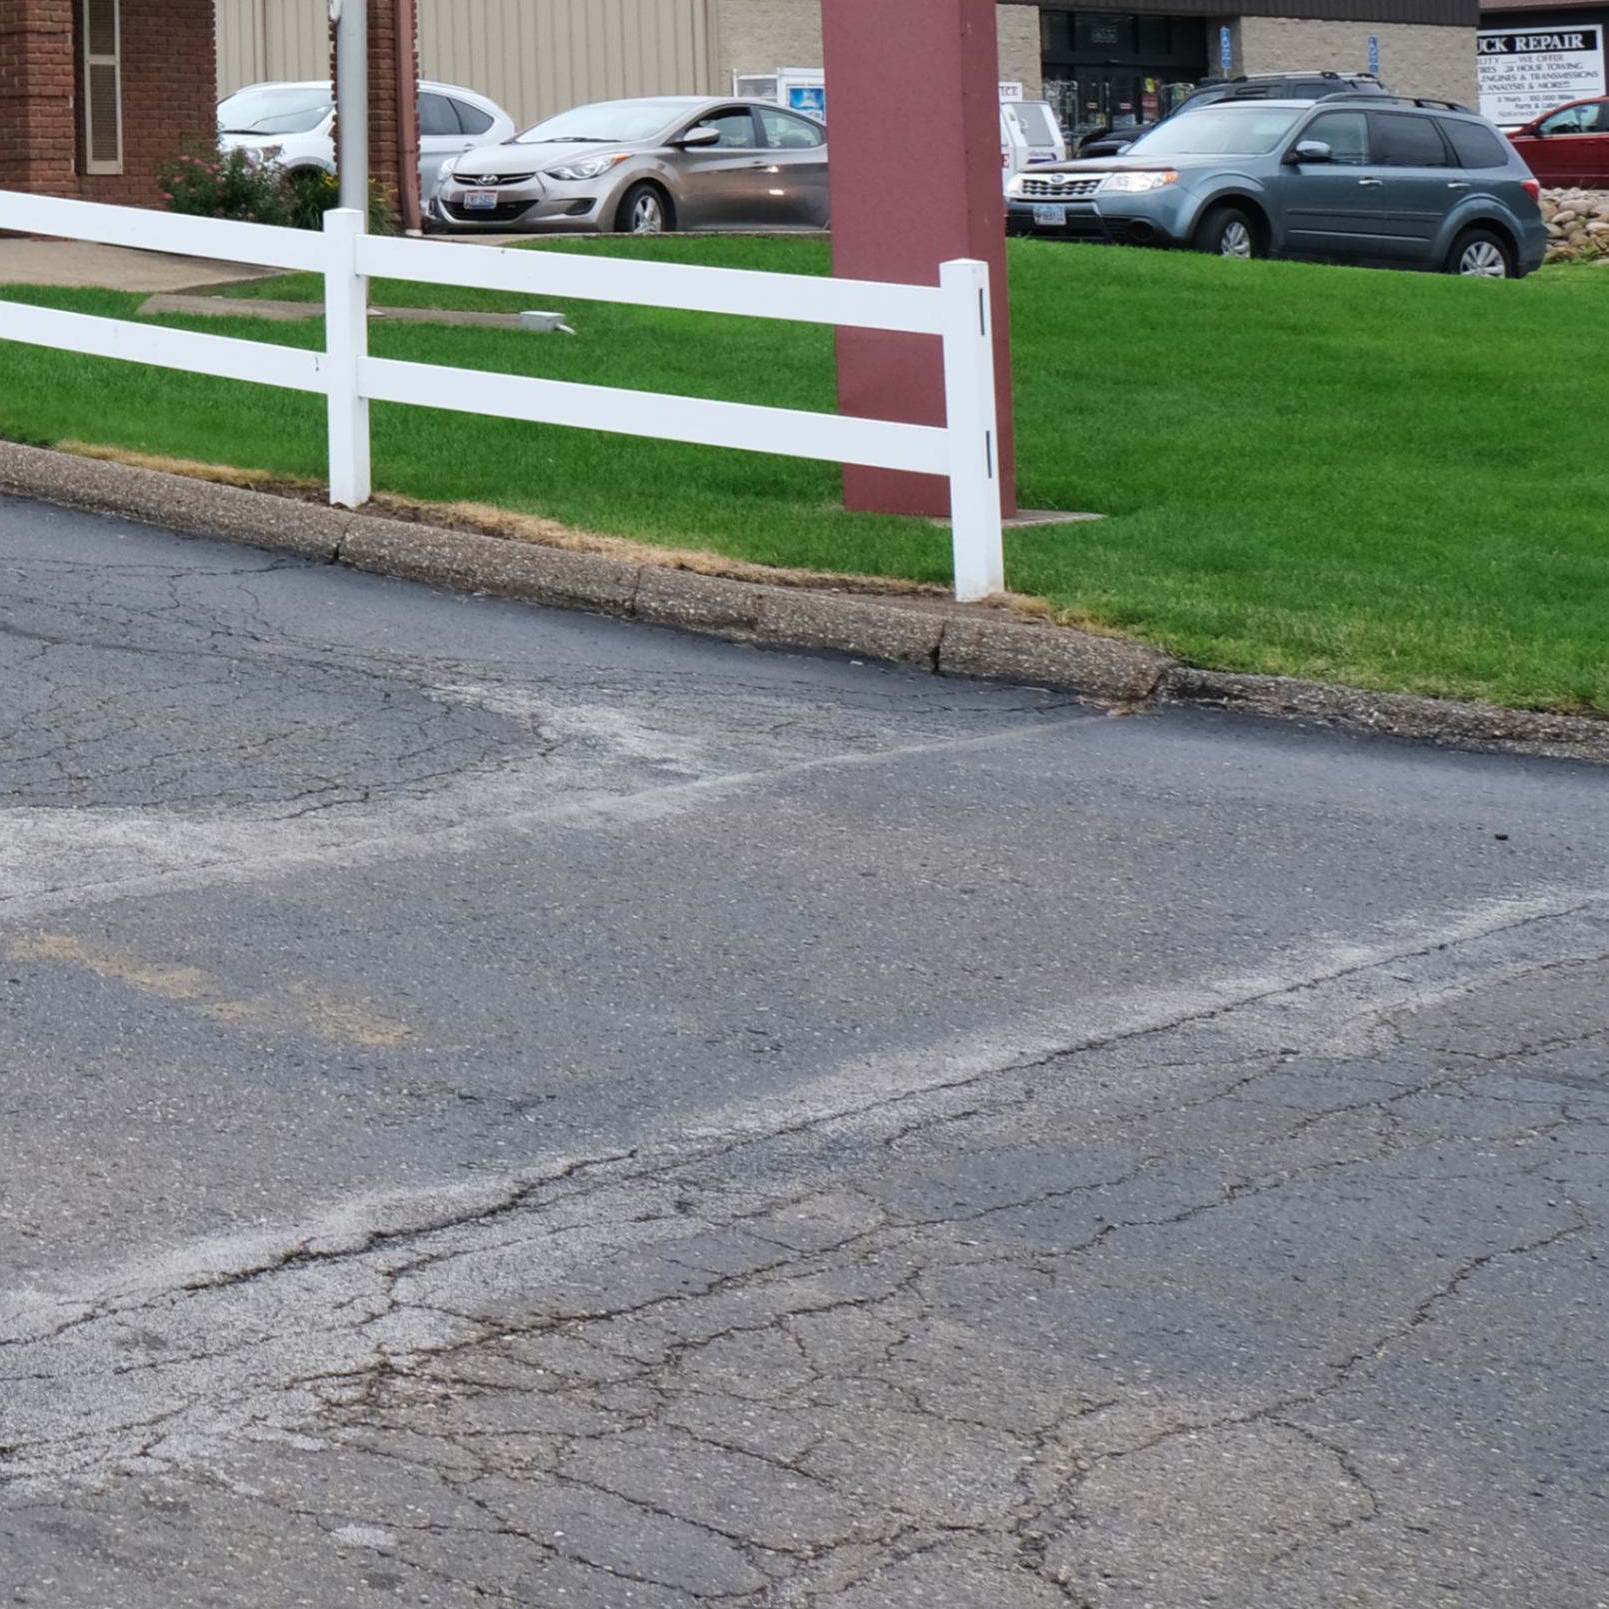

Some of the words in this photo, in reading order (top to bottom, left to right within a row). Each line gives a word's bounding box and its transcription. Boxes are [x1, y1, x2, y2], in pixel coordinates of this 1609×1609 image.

[1514, 33, 1585, 51] REPAIR
[1536, 54, 1565, 62] OFFER
[1546, 62, 1583, 71] TOWING
